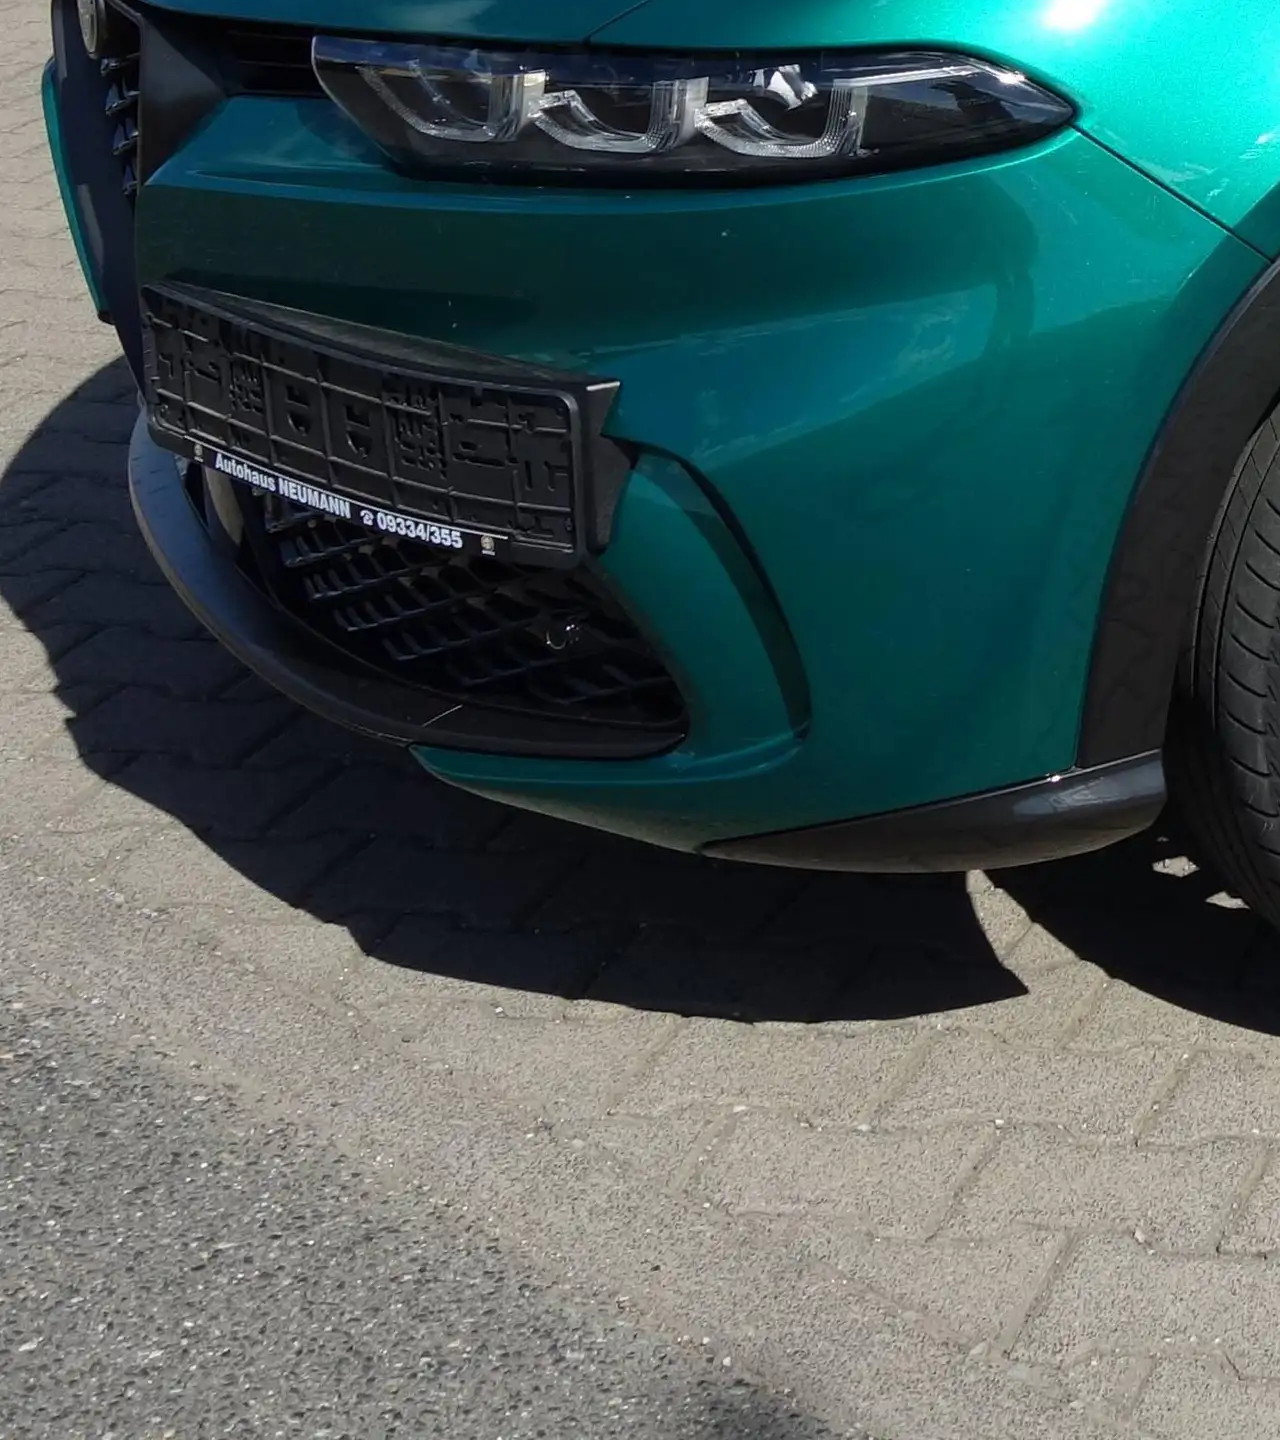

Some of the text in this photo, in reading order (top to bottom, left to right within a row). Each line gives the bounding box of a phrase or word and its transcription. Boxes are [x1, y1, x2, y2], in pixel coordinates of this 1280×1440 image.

[214, 452, 463, 549] Autohaus NEUMANN 09334/355
